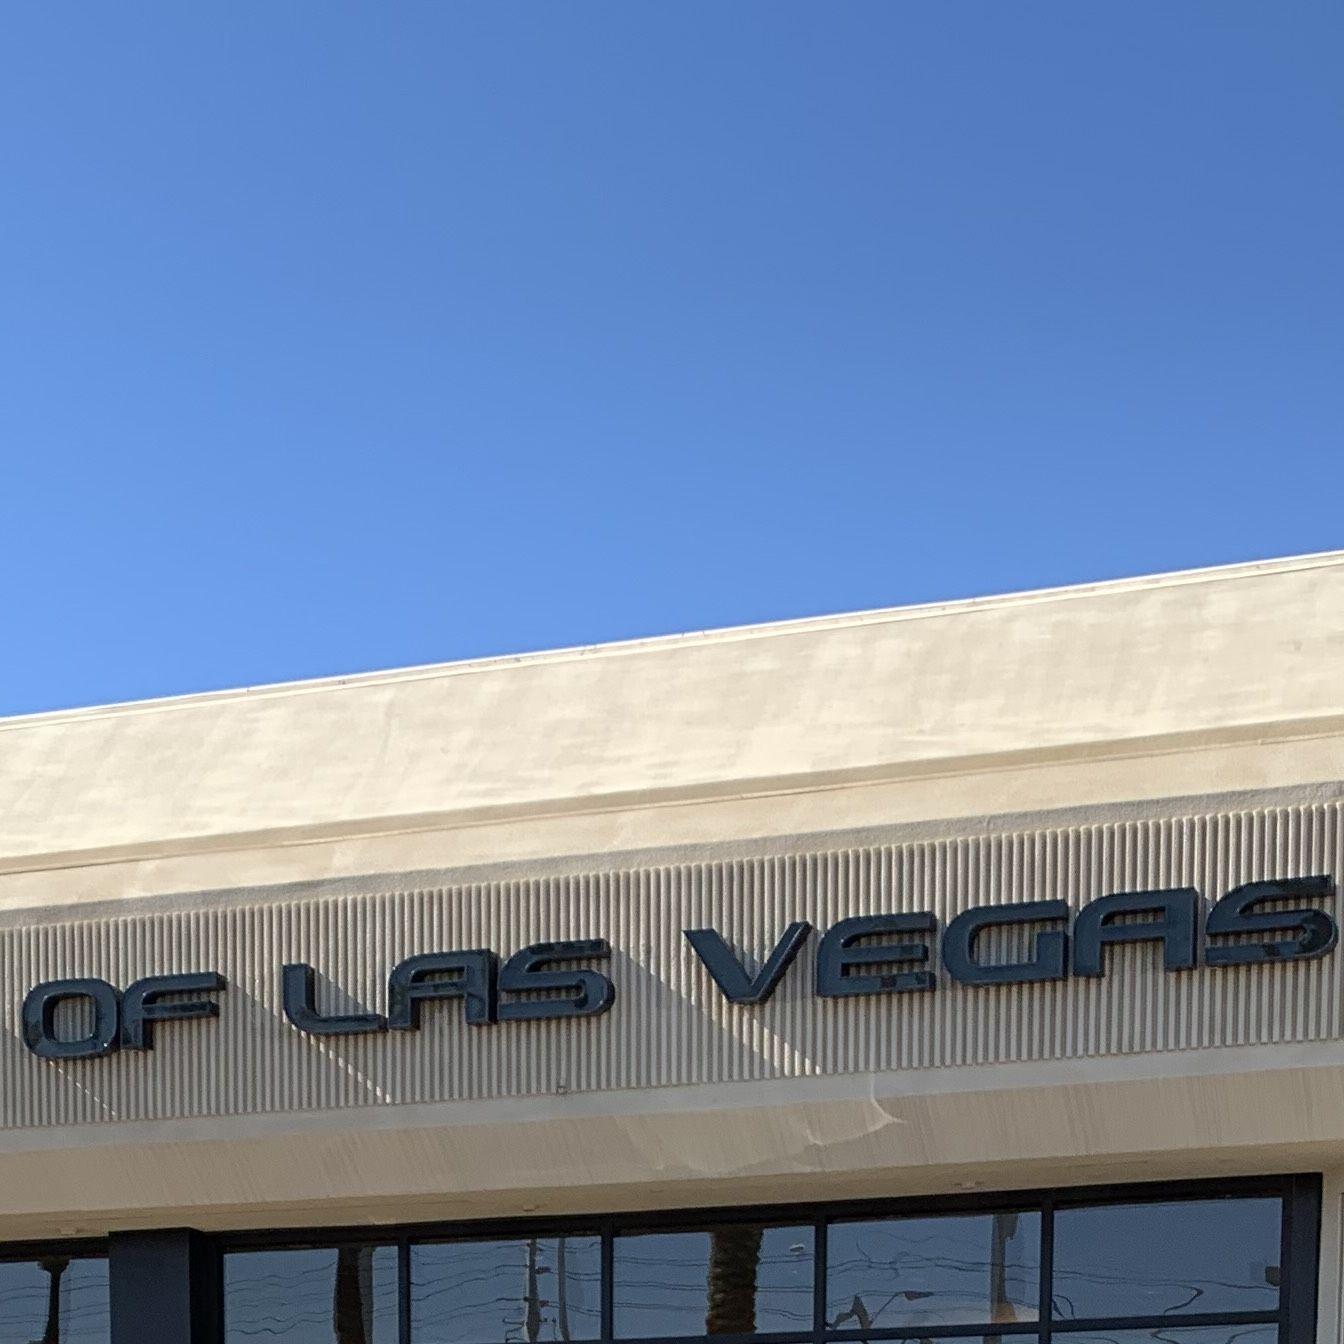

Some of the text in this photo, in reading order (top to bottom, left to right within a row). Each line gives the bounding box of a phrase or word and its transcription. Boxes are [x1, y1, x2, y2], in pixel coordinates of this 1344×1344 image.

[20, 971, 226, 1060] OF
[282, 937, 616, 1036] LAS
[683, 874, 1339, 1006] VEGAS
